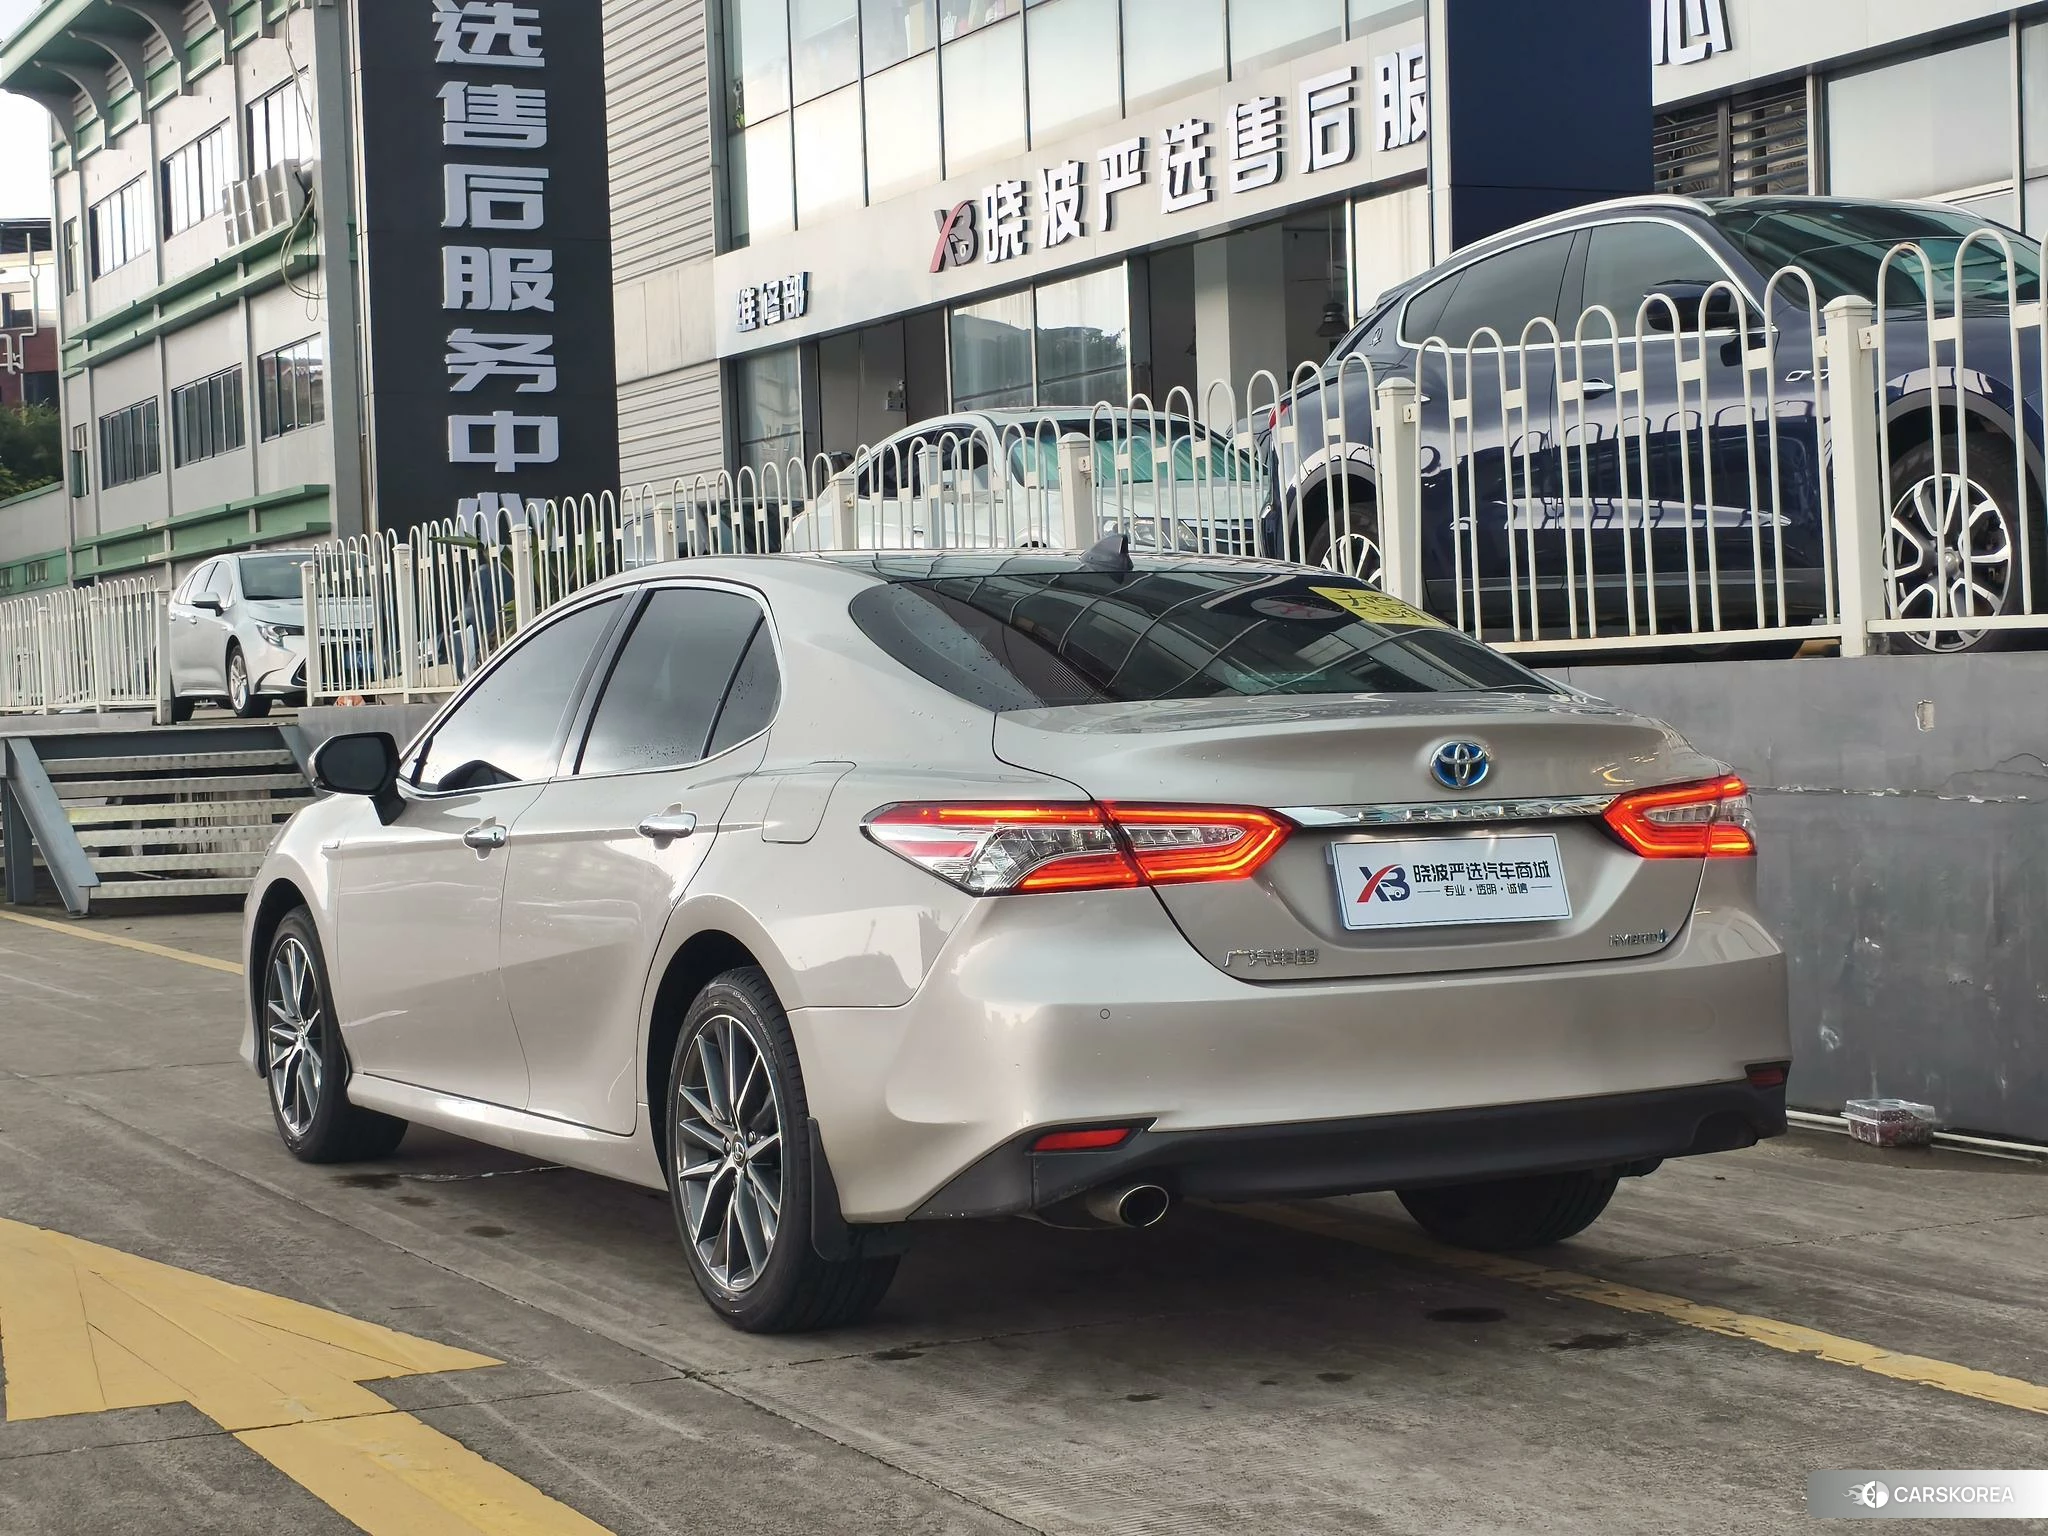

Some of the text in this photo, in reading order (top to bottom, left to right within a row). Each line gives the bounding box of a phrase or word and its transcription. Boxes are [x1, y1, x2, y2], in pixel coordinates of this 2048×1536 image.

[1413, 860, 1551, 883] 晓波严选汽车商城
